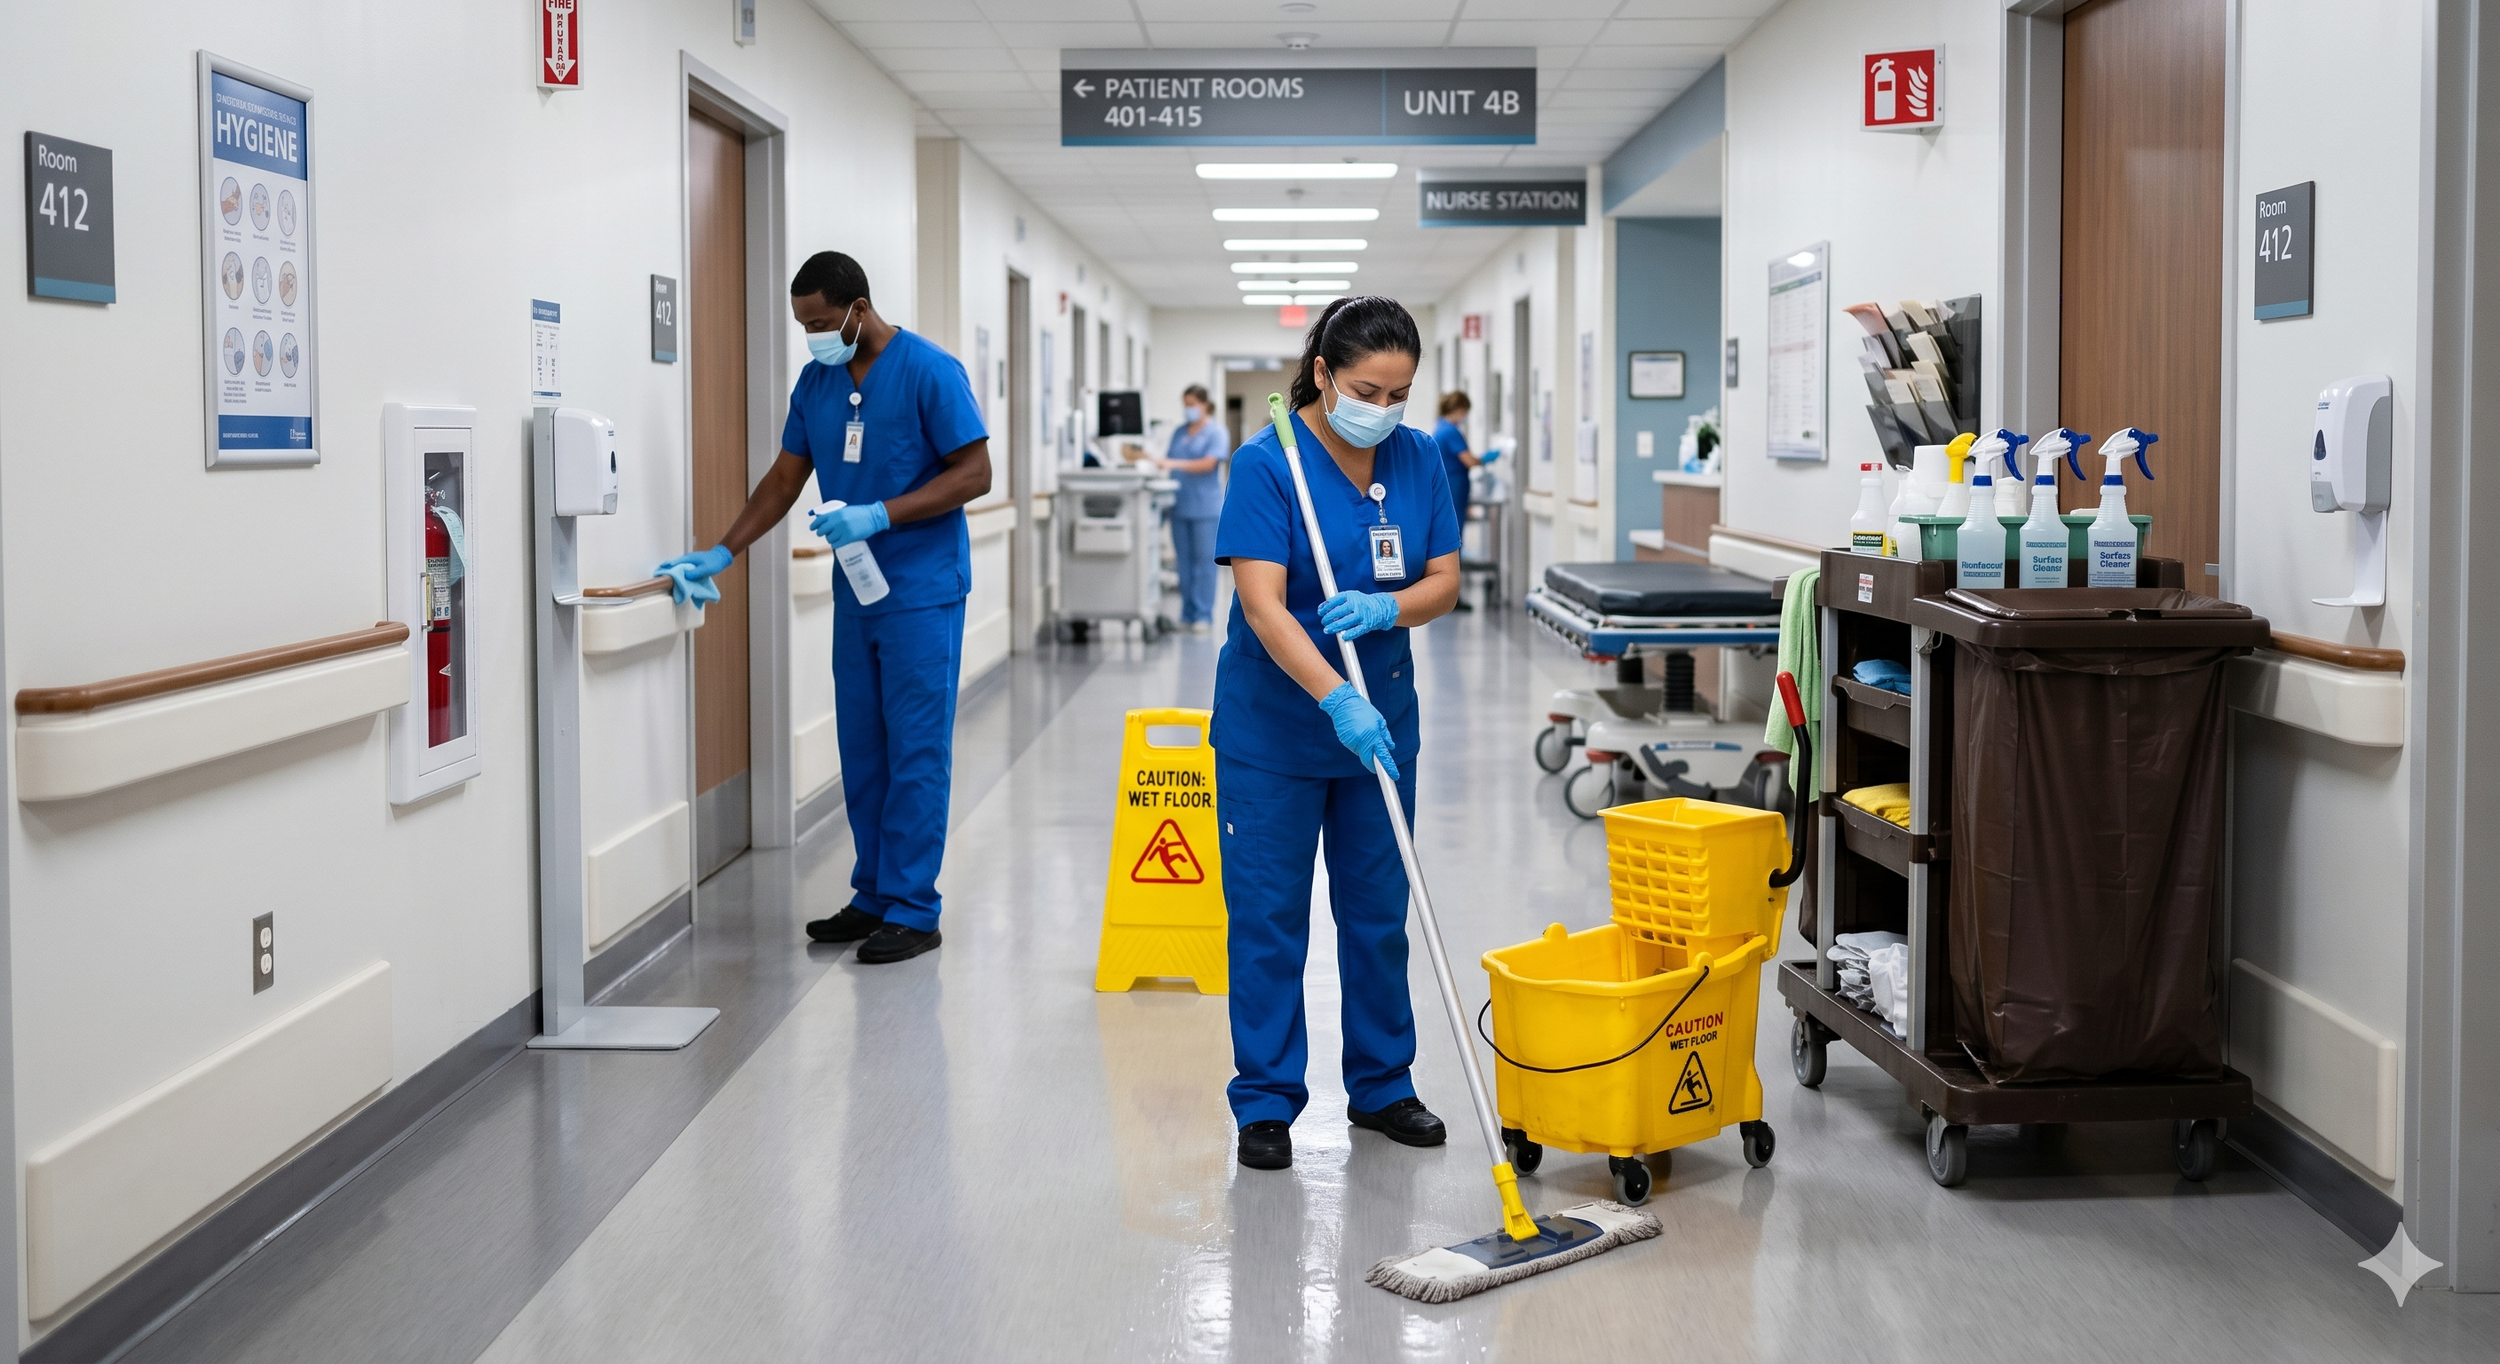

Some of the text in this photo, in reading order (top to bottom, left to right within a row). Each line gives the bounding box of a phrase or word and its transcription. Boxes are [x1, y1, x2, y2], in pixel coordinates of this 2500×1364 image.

[548, 0, 572, 9] FIRE
[1105, 78, 1304, 100] PATIENT ROOMS
[1404, 91, 1520, 116] UNIT 4B
[1104, 106, 1203, 128] 401-415
[217, 110, 297, 164] HYGIENE
[39, 143, 78, 173] Room
[40, 183, 89, 231] 412
[1425, 190, 1579, 211] NURSE STATION
[2260, 200, 2287, 218] Room
[2259, 225, 2292, 263] 412
[655, 299, 672, 326] 412
[2099, 560, 2131, 568] Cleaner
[1137, 770, 1206, 787] CAUTION:
[1128, 790, 1160, 807] WET
[1665, 1012, 1724, 1038] CAUTION
[1670, 1030, 1718, 1051] WET FLOOR
